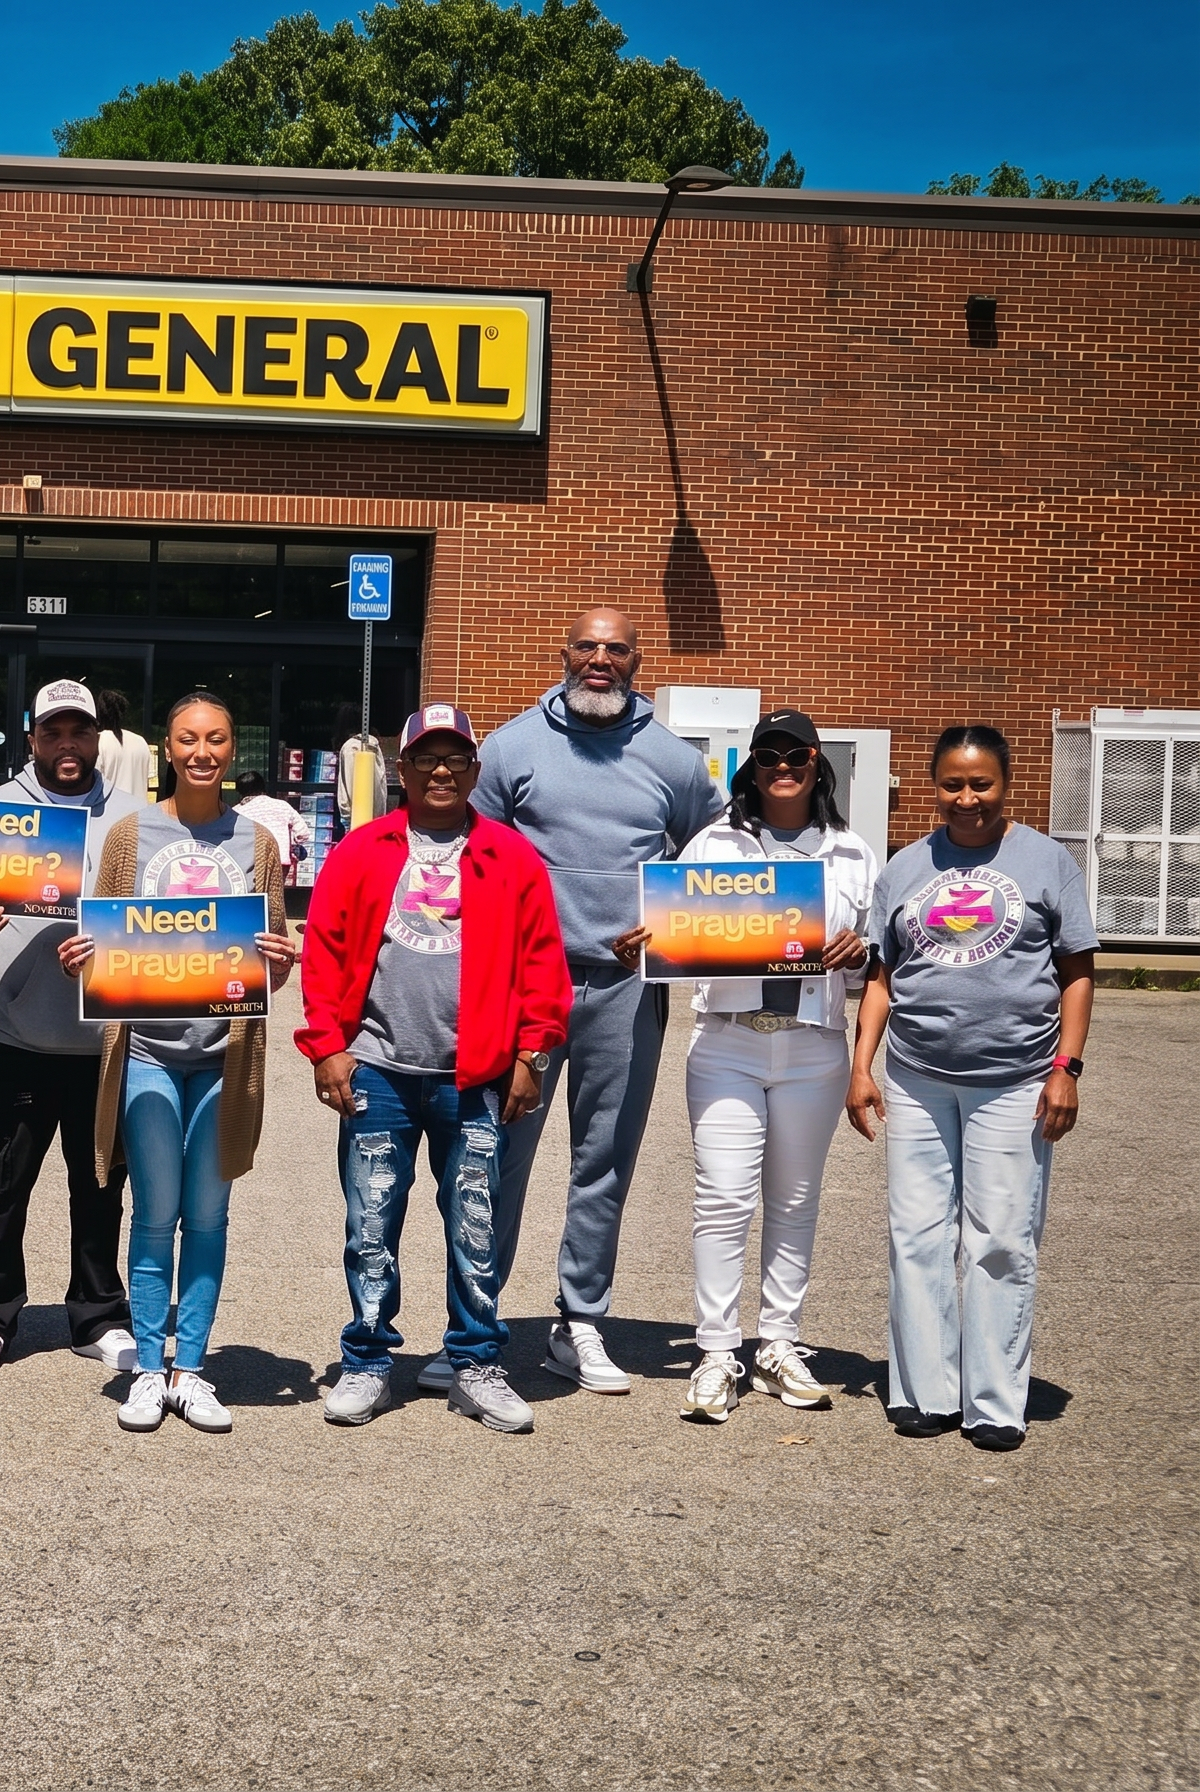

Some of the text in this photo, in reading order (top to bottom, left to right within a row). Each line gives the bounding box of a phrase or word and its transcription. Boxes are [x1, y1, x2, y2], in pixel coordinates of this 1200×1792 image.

[27, 307, 510, 405] GENERAL
[29, 598, 65, 614] 5311
[686, 866, 776, 896] Need
[126, 902, 217, 934] Need
[669, 907, 803, 943] Prayer?
[108, 945, 244, 983] Prayer?
